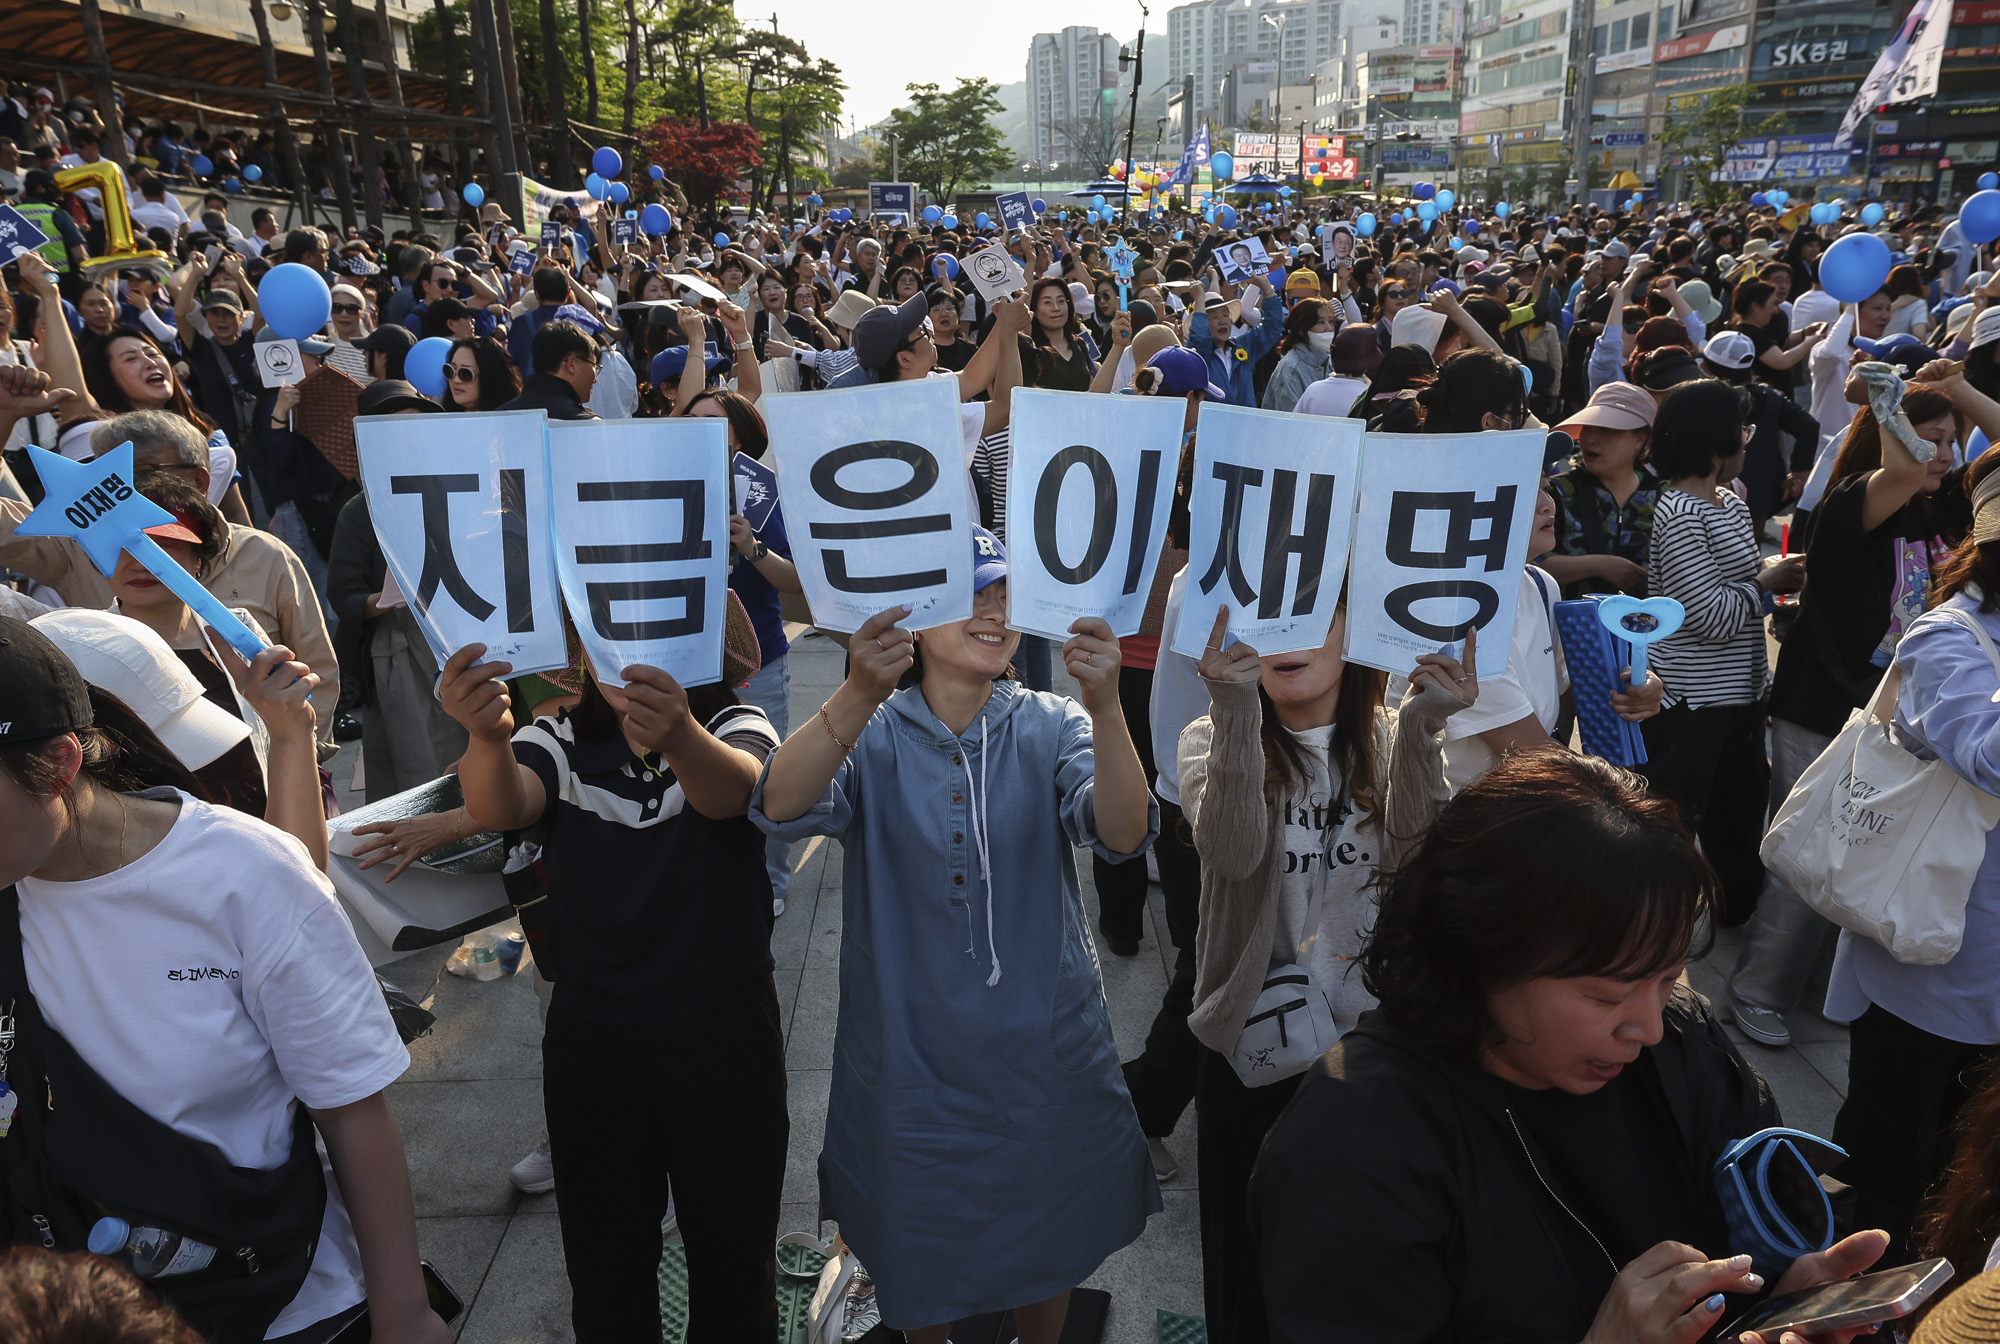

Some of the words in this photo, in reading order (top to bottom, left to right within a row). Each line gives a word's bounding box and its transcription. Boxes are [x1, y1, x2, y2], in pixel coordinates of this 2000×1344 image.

[1772, 39, 1848, 67] SK증권
[1216, 249, 1229, 264] 1
[65, 472, 133, 529] 이재명
[974, 536, 998, 557] R
[167, 966, 240, 982] ELIMENO
